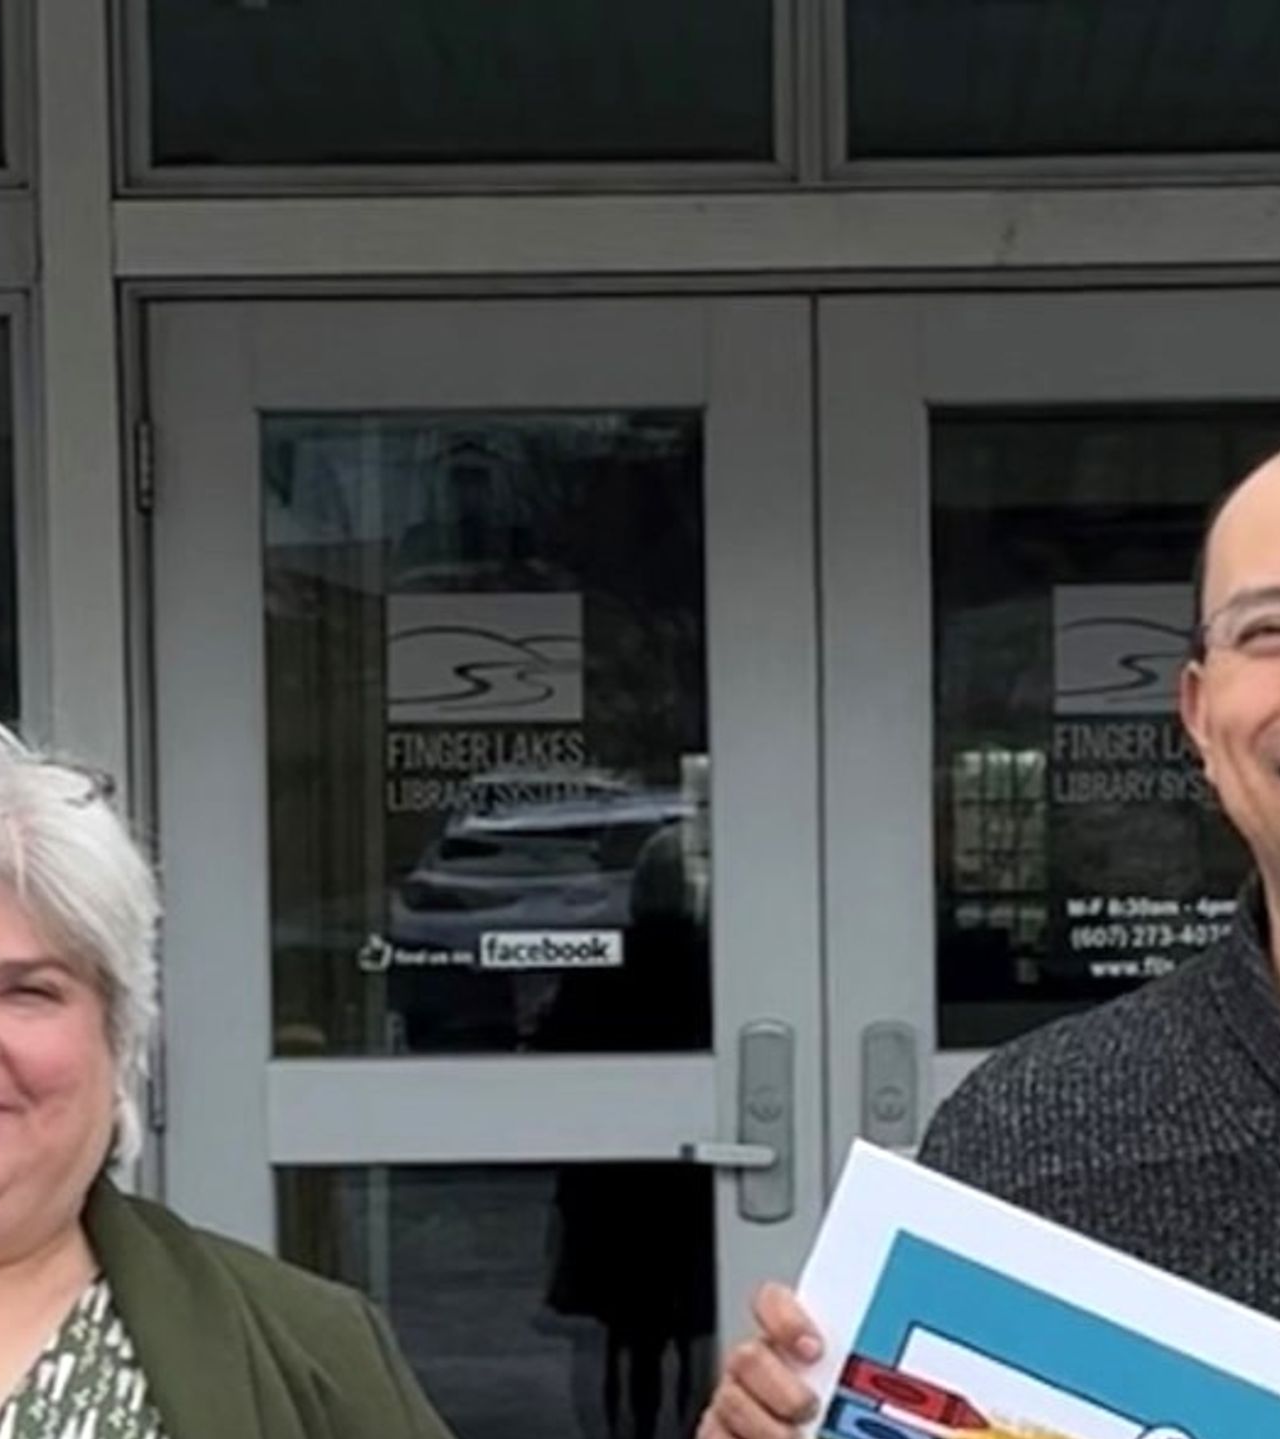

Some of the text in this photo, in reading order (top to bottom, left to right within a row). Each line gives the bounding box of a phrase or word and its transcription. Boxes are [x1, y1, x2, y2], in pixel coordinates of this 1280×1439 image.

[388, 732, 584, 769] FINGER LAKES
[1054, 723, 1156, 760] FINGER
[1054, 770, 1154, 802] LIBRARY
[487, 937, 609, 962] facebook
